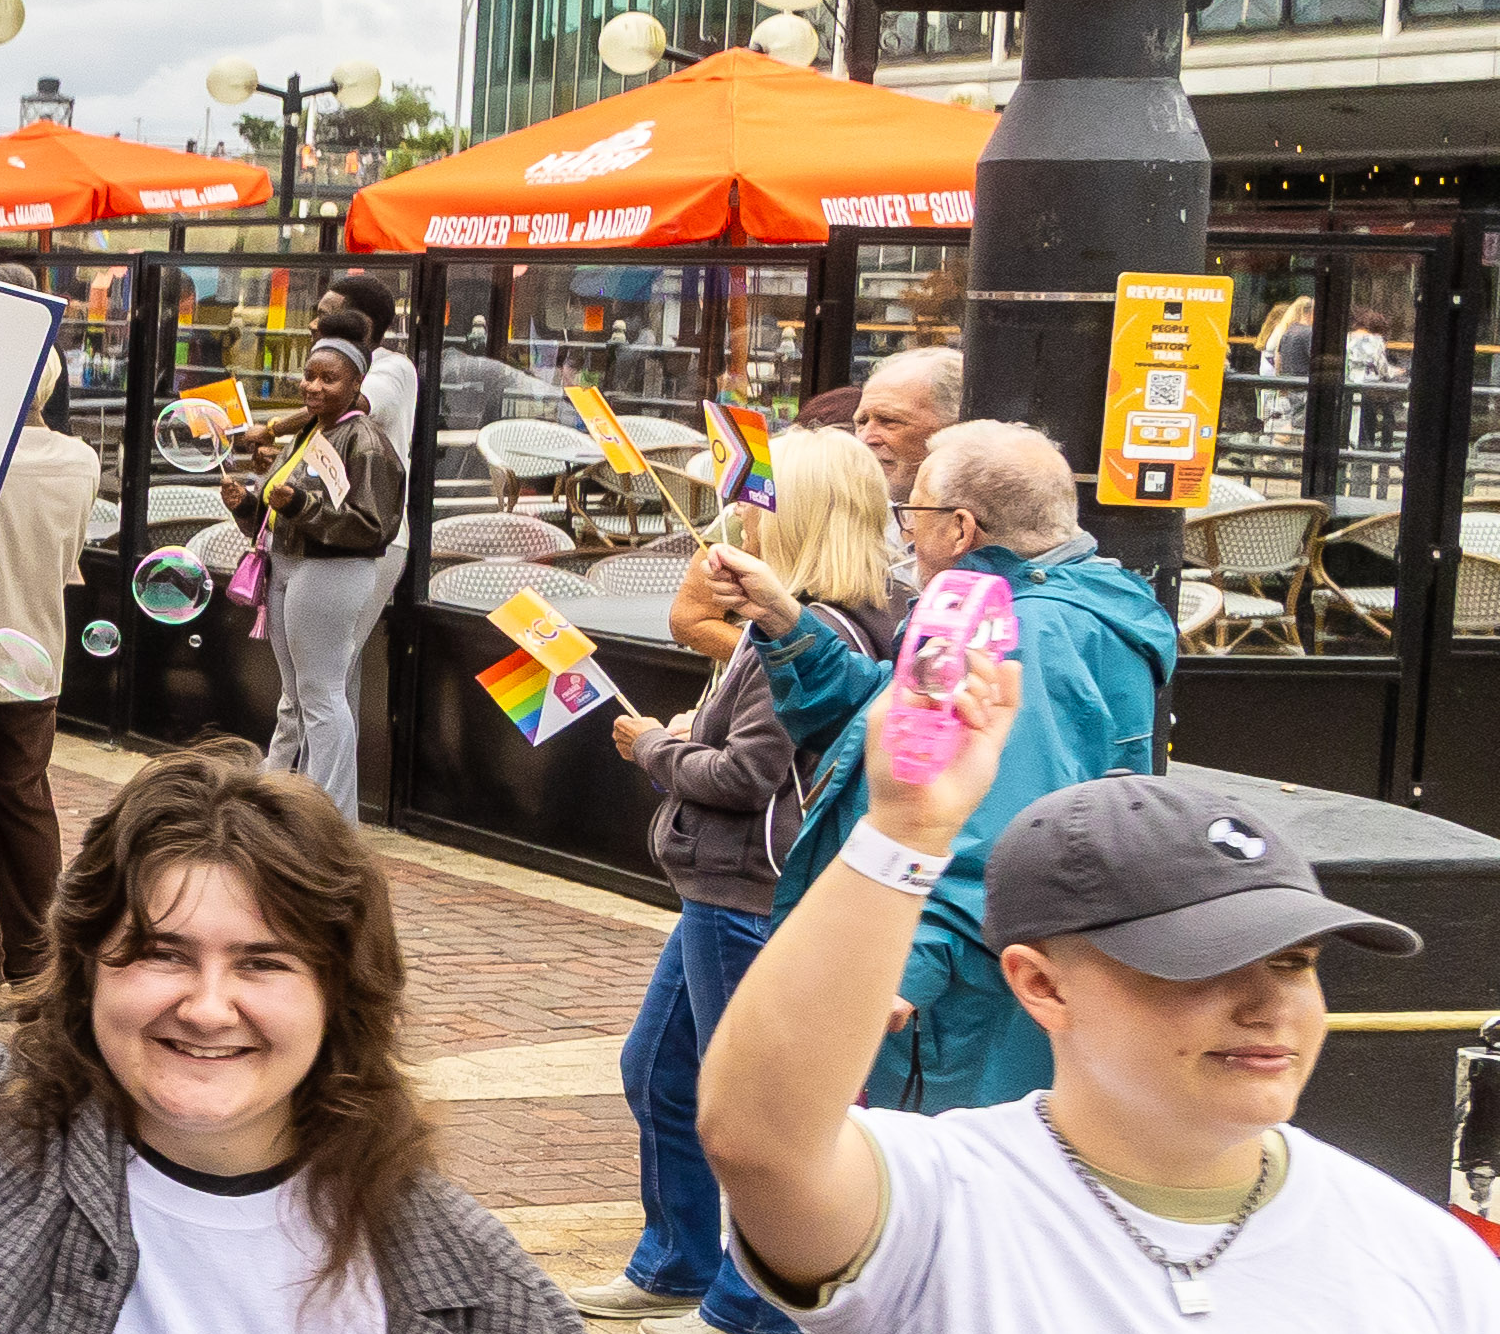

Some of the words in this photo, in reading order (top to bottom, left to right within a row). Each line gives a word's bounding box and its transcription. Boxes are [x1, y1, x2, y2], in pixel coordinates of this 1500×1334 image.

[820, 193, 912, 228] DISCOVER
[906, 193, 929, 211] THE
[423, 215, 511, 246] DISCOVER
[512, 214, 531, 233] THE
[528, 213, 570, 244] SOUL
[583, 205, 653, 241] MADRID
[1126, 285, 1185, 301] REVEAL
[1185, 287, 1226, 303] HULL
[1151, 324, 1190, 334] PEOPLE
[1145, 342, 1192, 352] HISTORY
